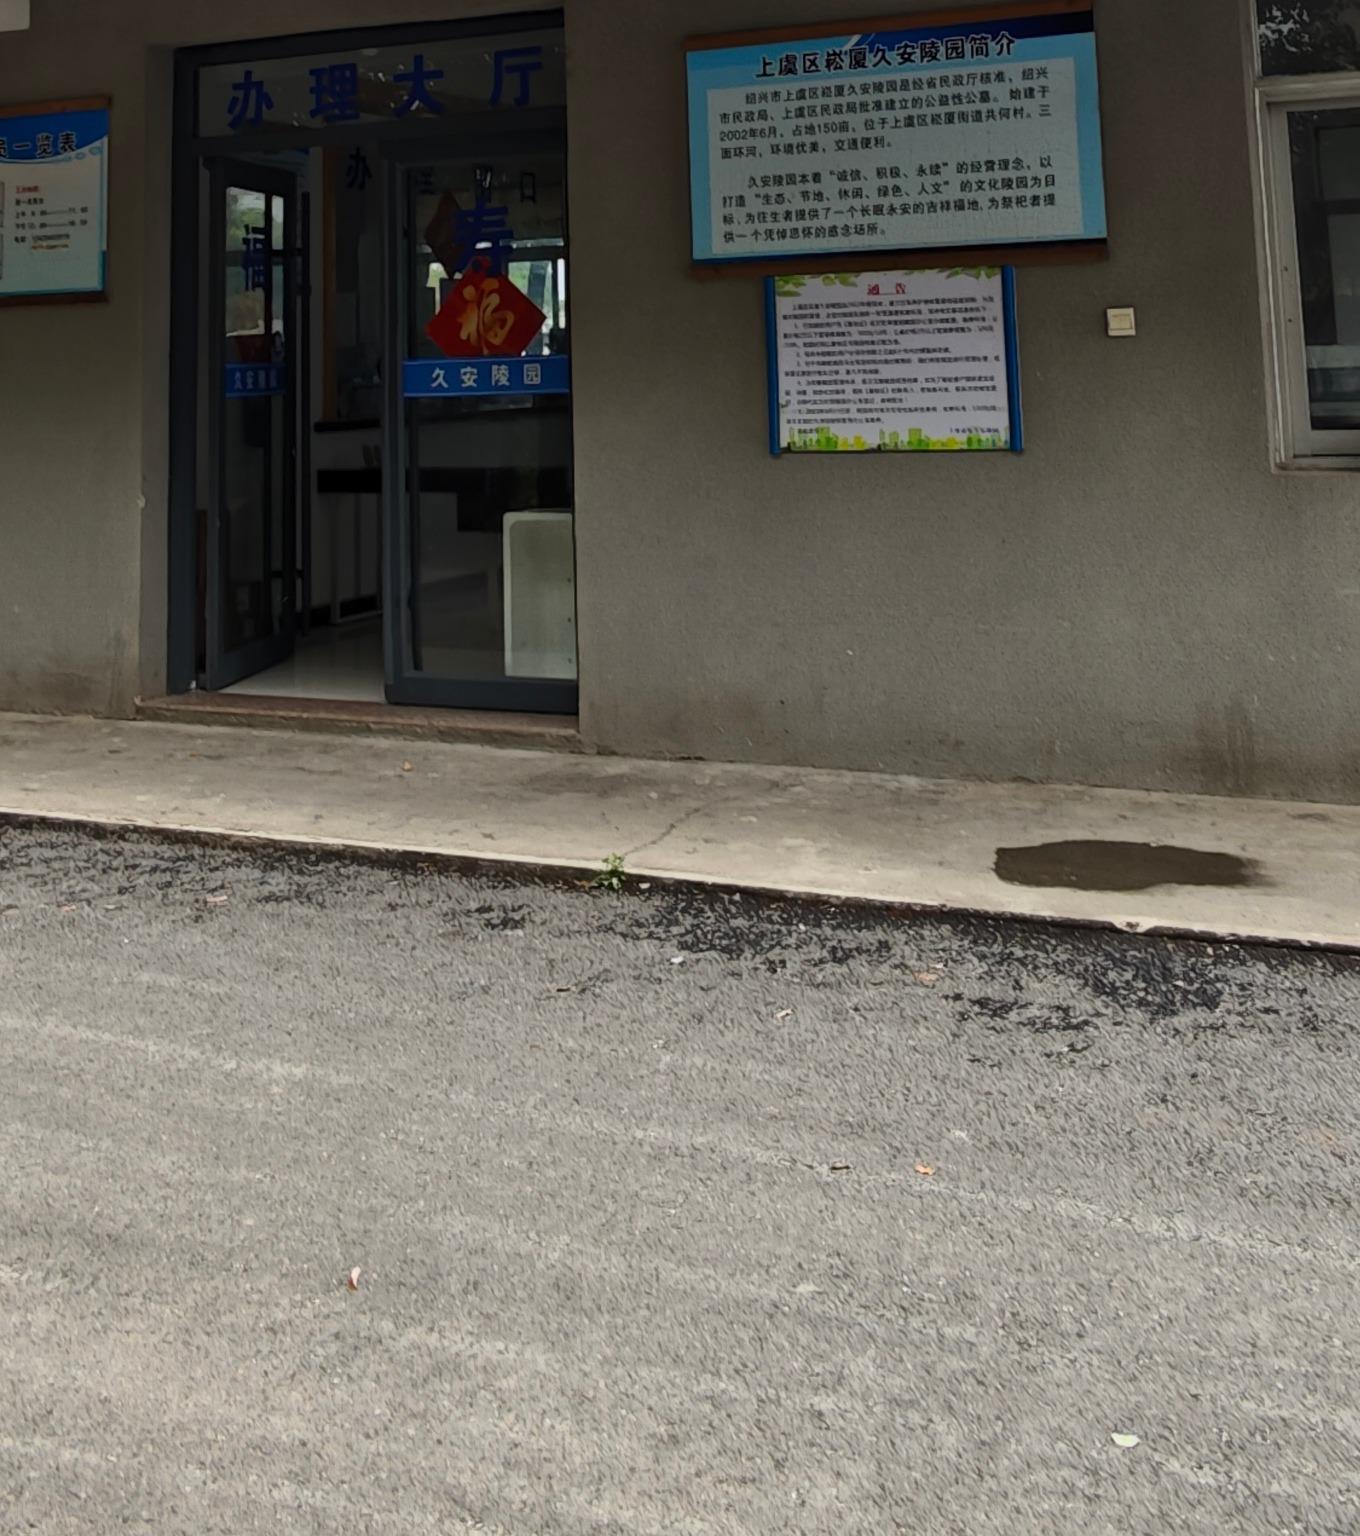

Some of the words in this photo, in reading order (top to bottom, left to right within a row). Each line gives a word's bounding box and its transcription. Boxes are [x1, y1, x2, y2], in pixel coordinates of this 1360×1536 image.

[754, 31, 1017, 78] 上虞区崧厦久安陵园简介
[227, 46, 544, 131] 办理大厅
[458, 277, 515, 356] 福
[431, 362, 542, 389] 久安陵园
